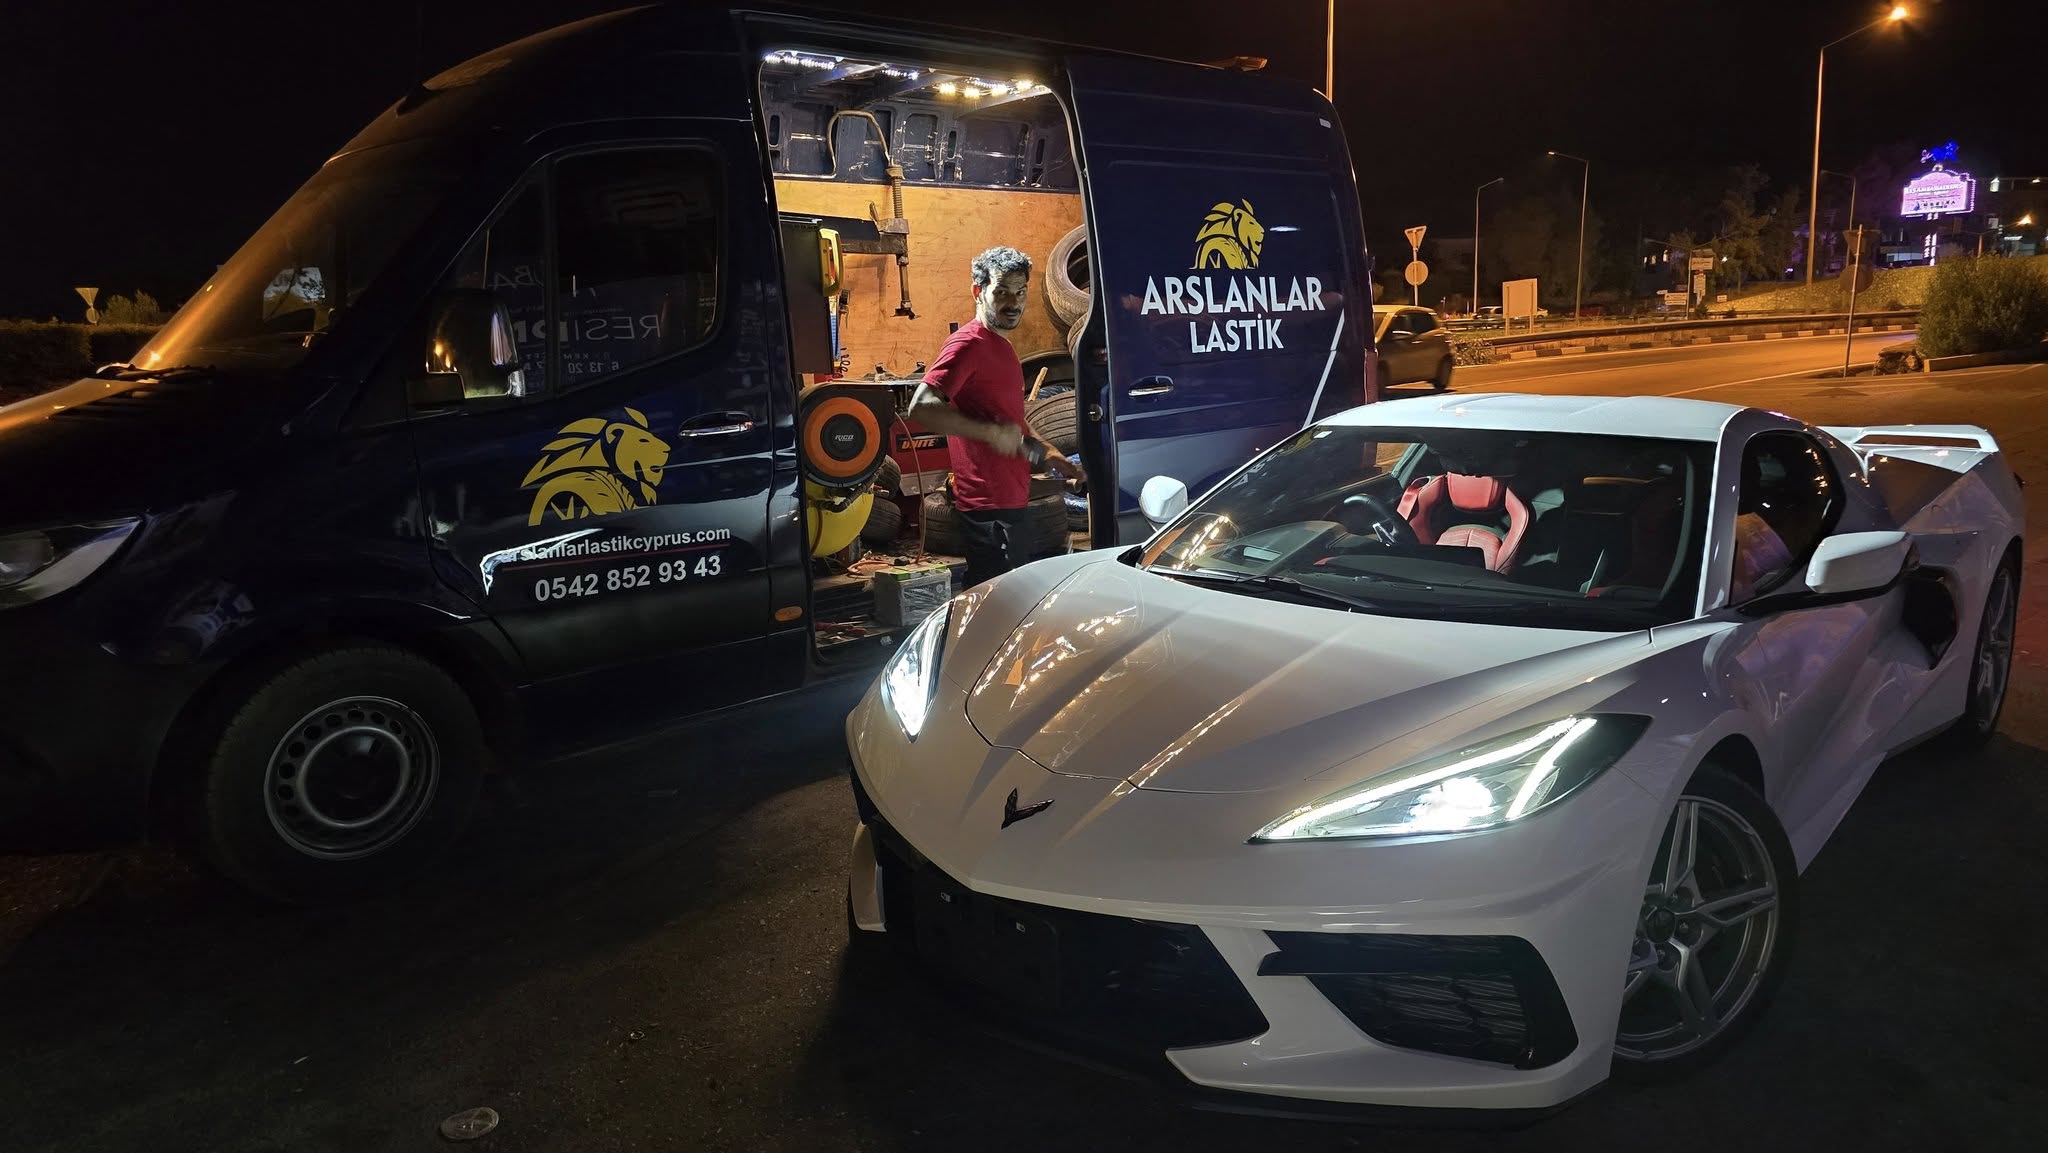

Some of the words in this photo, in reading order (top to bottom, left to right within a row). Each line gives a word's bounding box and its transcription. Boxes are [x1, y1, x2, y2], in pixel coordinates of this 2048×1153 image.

[1140, 275, 1326, 315] ARSLANLAR
[1189, 313, 1285, 353] LASTİK
[901, 438, 936, 449] UNITE
[534, 572, 600, 602] 0542
[606, 564, 651, 591] 852
[657, 559, 687, 584] 93
[693, 554, 722, 578] 43
